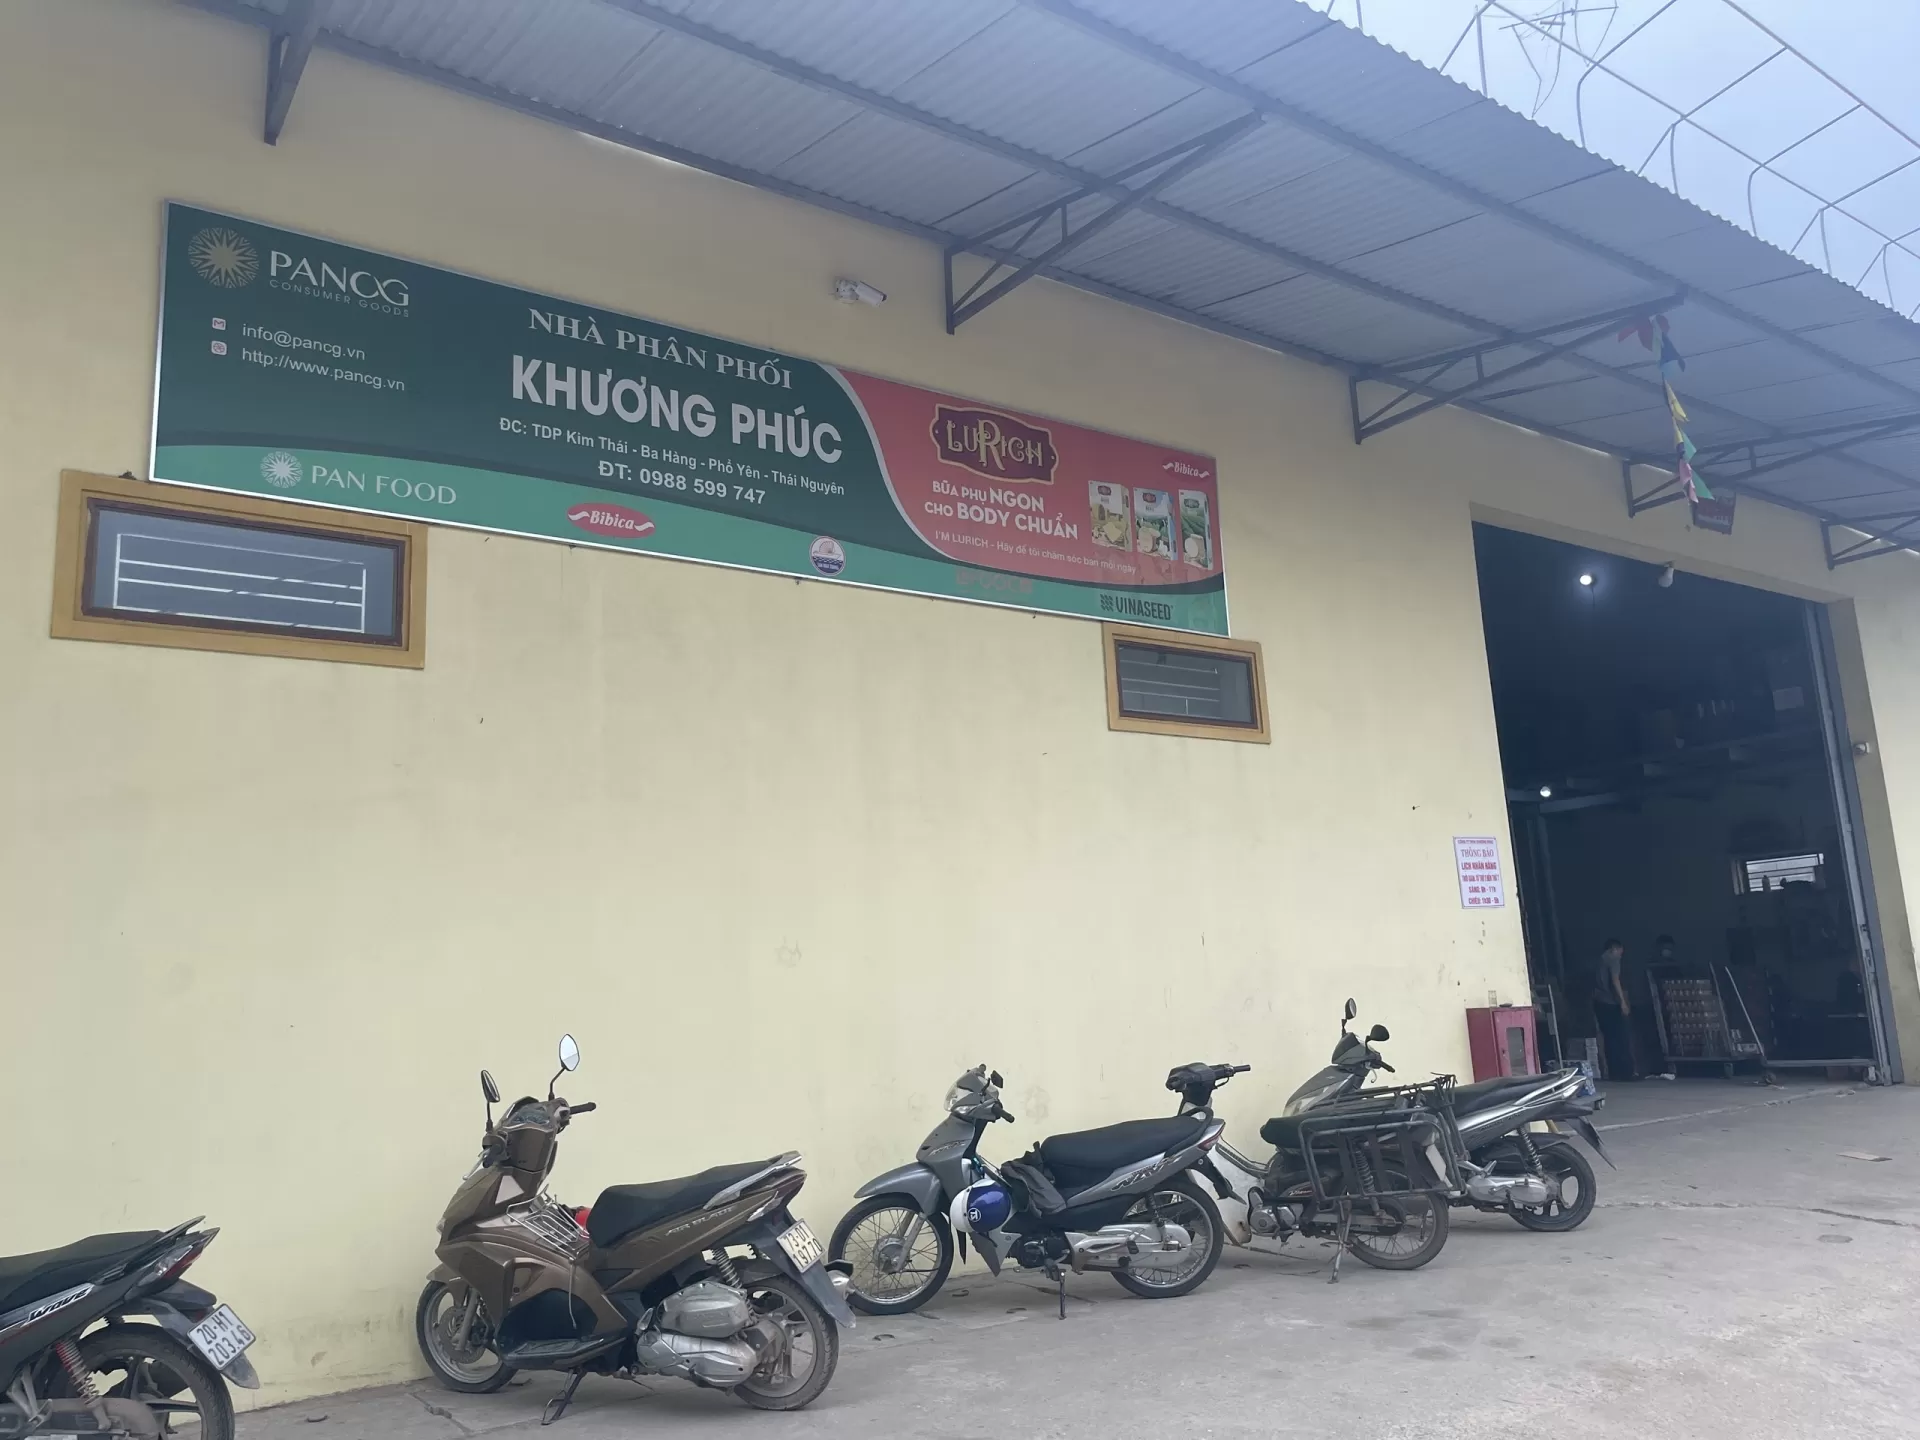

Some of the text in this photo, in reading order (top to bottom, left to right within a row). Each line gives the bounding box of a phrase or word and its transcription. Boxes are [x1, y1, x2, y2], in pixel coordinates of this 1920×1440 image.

[269, 279, 409, 317] CONSUMER GOODS
[242, 323, 366, 360] info@pancg.vn
[528, 308, 793, 390] NHÀ PHÂN PHỐI
[242, 347, 405, 391] http://www.pancg.vn
[512, 355, 843, 464] KHƯƠNG PHÚC
[500, 417, 527, 435] ĐC:
[532, 423, 563, 441] TDP
[566, 430, 594, 448] Kim
[598, 436, 628, 454] Thái
[641, 445, 659, 459] Ba
[662, 449, 697, 470] Hàng
[736, 463, 761, 480] Yên
[771, 471, 798, 486] Thái
[801, 476, 845, 496] Nguyên
[1174, 461, 1199, 477] Bibica
[312, 465, 457, 504] PAN FOOD
[598, 460, 766, 505] ĐT: 0988 599 747
[961, 487, 987, 503] PHỤ
[988, 488, 1044, 513] NGON
[589, 510, 635, 530] Bibica
[924, 501, 1078, 540] CHO BODY CHUẨN
[935, 530, 950, 541] I'M
[952, 533, 989, 549] LURICH
[997, 542, 1014, 554] Hãy
[1029, 546, 1040, 557] tôi
[1115, 596, 1171, 621] VINASEED
[793, 1238, 823, 1268] 197.70
[208, 1325, 251, 1366] 203.46
